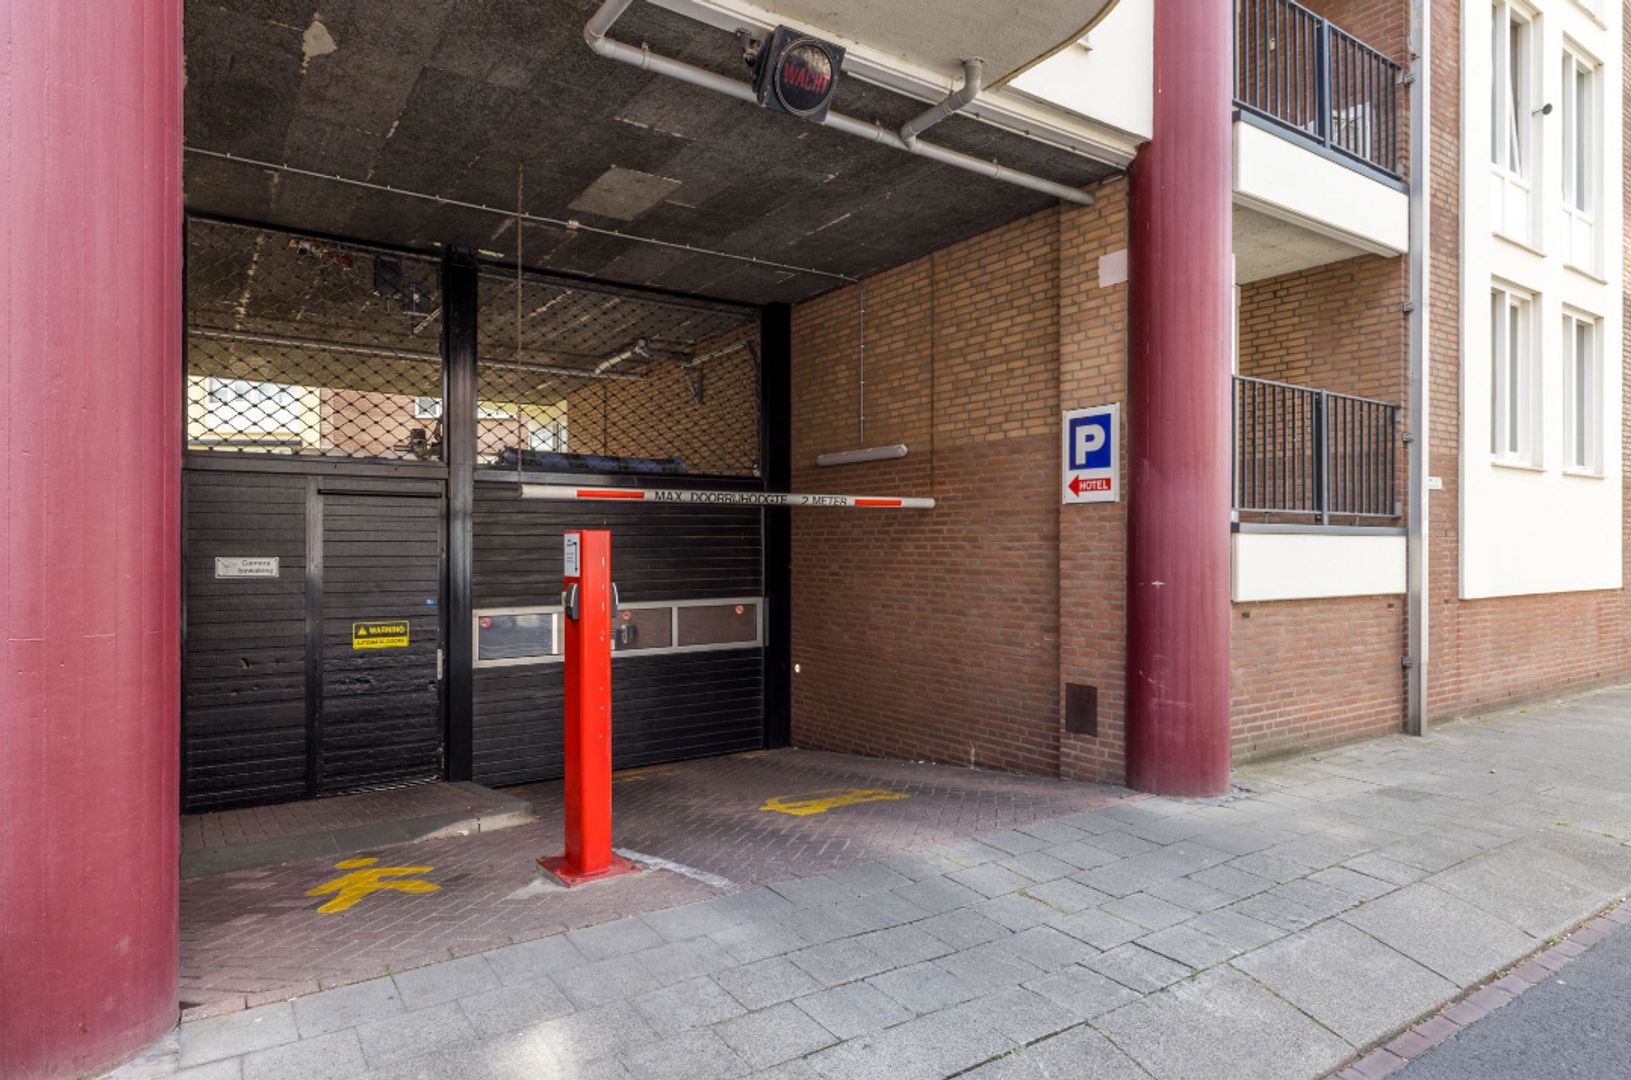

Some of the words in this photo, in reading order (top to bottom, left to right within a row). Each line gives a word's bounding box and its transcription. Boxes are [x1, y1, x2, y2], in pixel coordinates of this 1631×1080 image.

[783, 63, 831, 94] WACHT
[1075, 424, 1106, 465] P
[1079, 480, 1108, 491] HOTEL
[801, 496, 809, 505] 2
[812, 496, 847, 506] METER
[369, 625, 404, 634] WARNING
